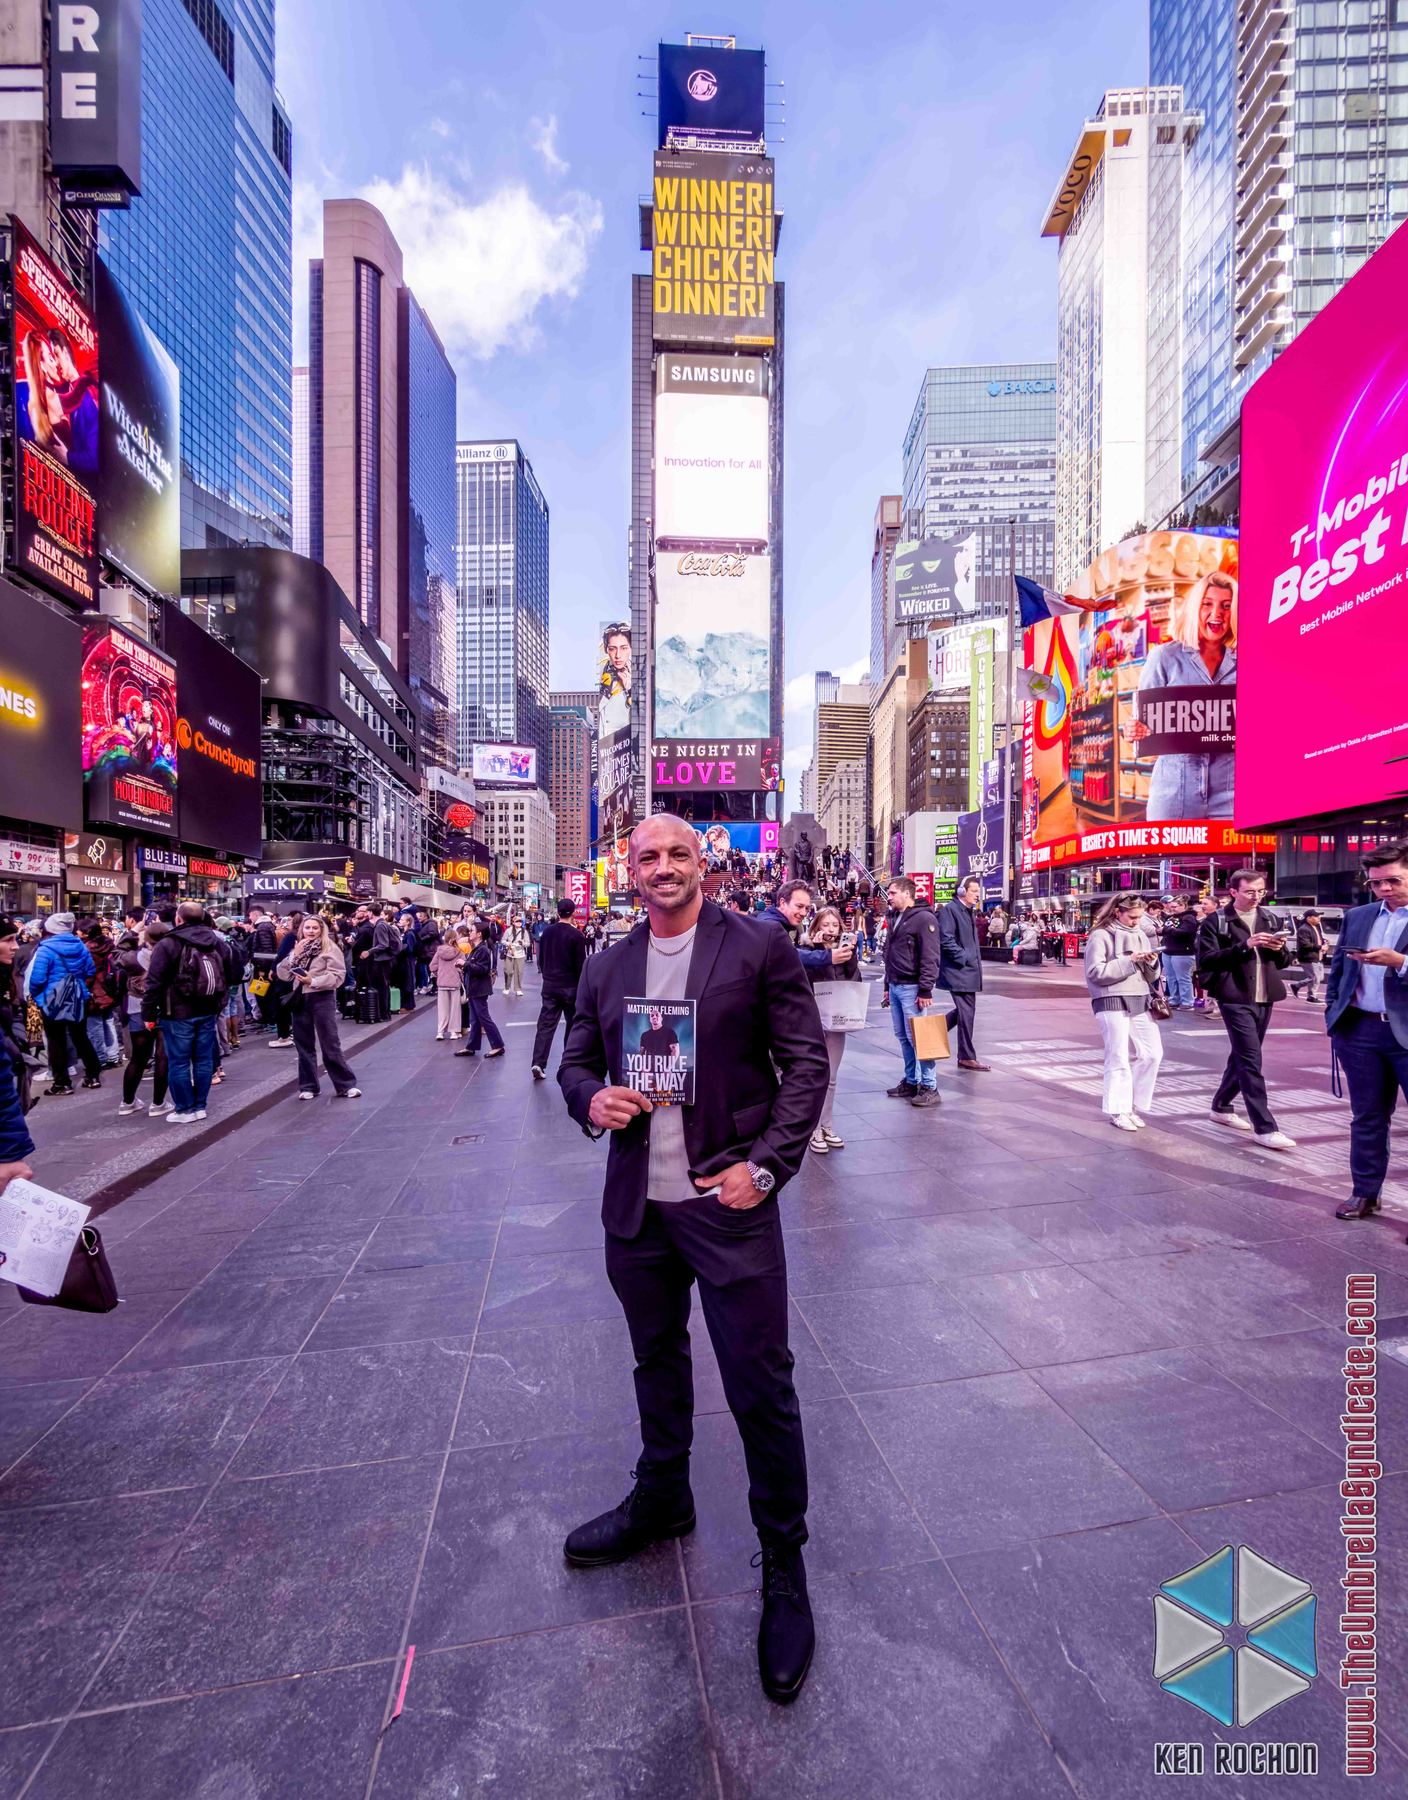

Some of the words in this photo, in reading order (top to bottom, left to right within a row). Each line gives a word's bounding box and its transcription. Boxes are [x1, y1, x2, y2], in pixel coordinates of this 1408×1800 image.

[654, 177, 772, 216] WINNER!
[654, 211, 772, 249] WINNER!
[654, 246, 774, 285] CHICKEN
[20, 249, 95, 351] SPECTACULAR
[654, 279, 766, 318] DINNER!
[671, 366, 755, 383] SAMSUNG
[103, 382, 147, 450] Witch
[148, 435, 173, 482] Hat
[116, 433, 163, 495] Atelier
[456, 449, 491, 459] Allianz
[664, 456, 725, 469] Innovation
[729, 457, 744, 469] for
[748, 459, 762, 470] All
[23, 449, 85, 523] MOULIN
[34, 534, 62, 565] GREAT
[28, 547, 73, 589] AVAILABLE
[678, 553, 748, 577] Coca-Cola
[1268, 507, 1392, 624] Best
[1300, 617, 1320, 635] Best
[1321, 600, 1353, 625] Mobile
[1356, 573, 1402, 605] Network
[936, 626, 971, 651] LITTLE
[208, 716, 222, 731] ONLY
[676, 744, 730, 757] NIGHT
[737, 744, 756, 757] IN
[1201, 734, 1219, 742] milk
[194, 731, 256, 778] Crunchyroll
[656, 762, 736, 785] LOVE
[1081, 830, 1115, 853] HERSHEY'S
[1117, 828, 1160, 847] TIME'S
[1162, 826, 1208, 847] SQUARE
[9, 860, 22, 870] NY
[145, 848, 170, 863] BLUE
[172, 854, 187, 866] FIN
[84, 876, 114, 887] HEYTEA
[254, 877, 315, 890] KLIKTIX
[571, 873, 587, 905] tkts
[627, 1004, 659, 1014] MATTHEW
[660, 1005, 689, 1016] FLEMING
[626, 1053, 652, 1072] YOU
[655, 1055, 687, 1073] RULE
[626, 1071, 653, 1091] THE
[655, 1072, 687, 1092] WAY
